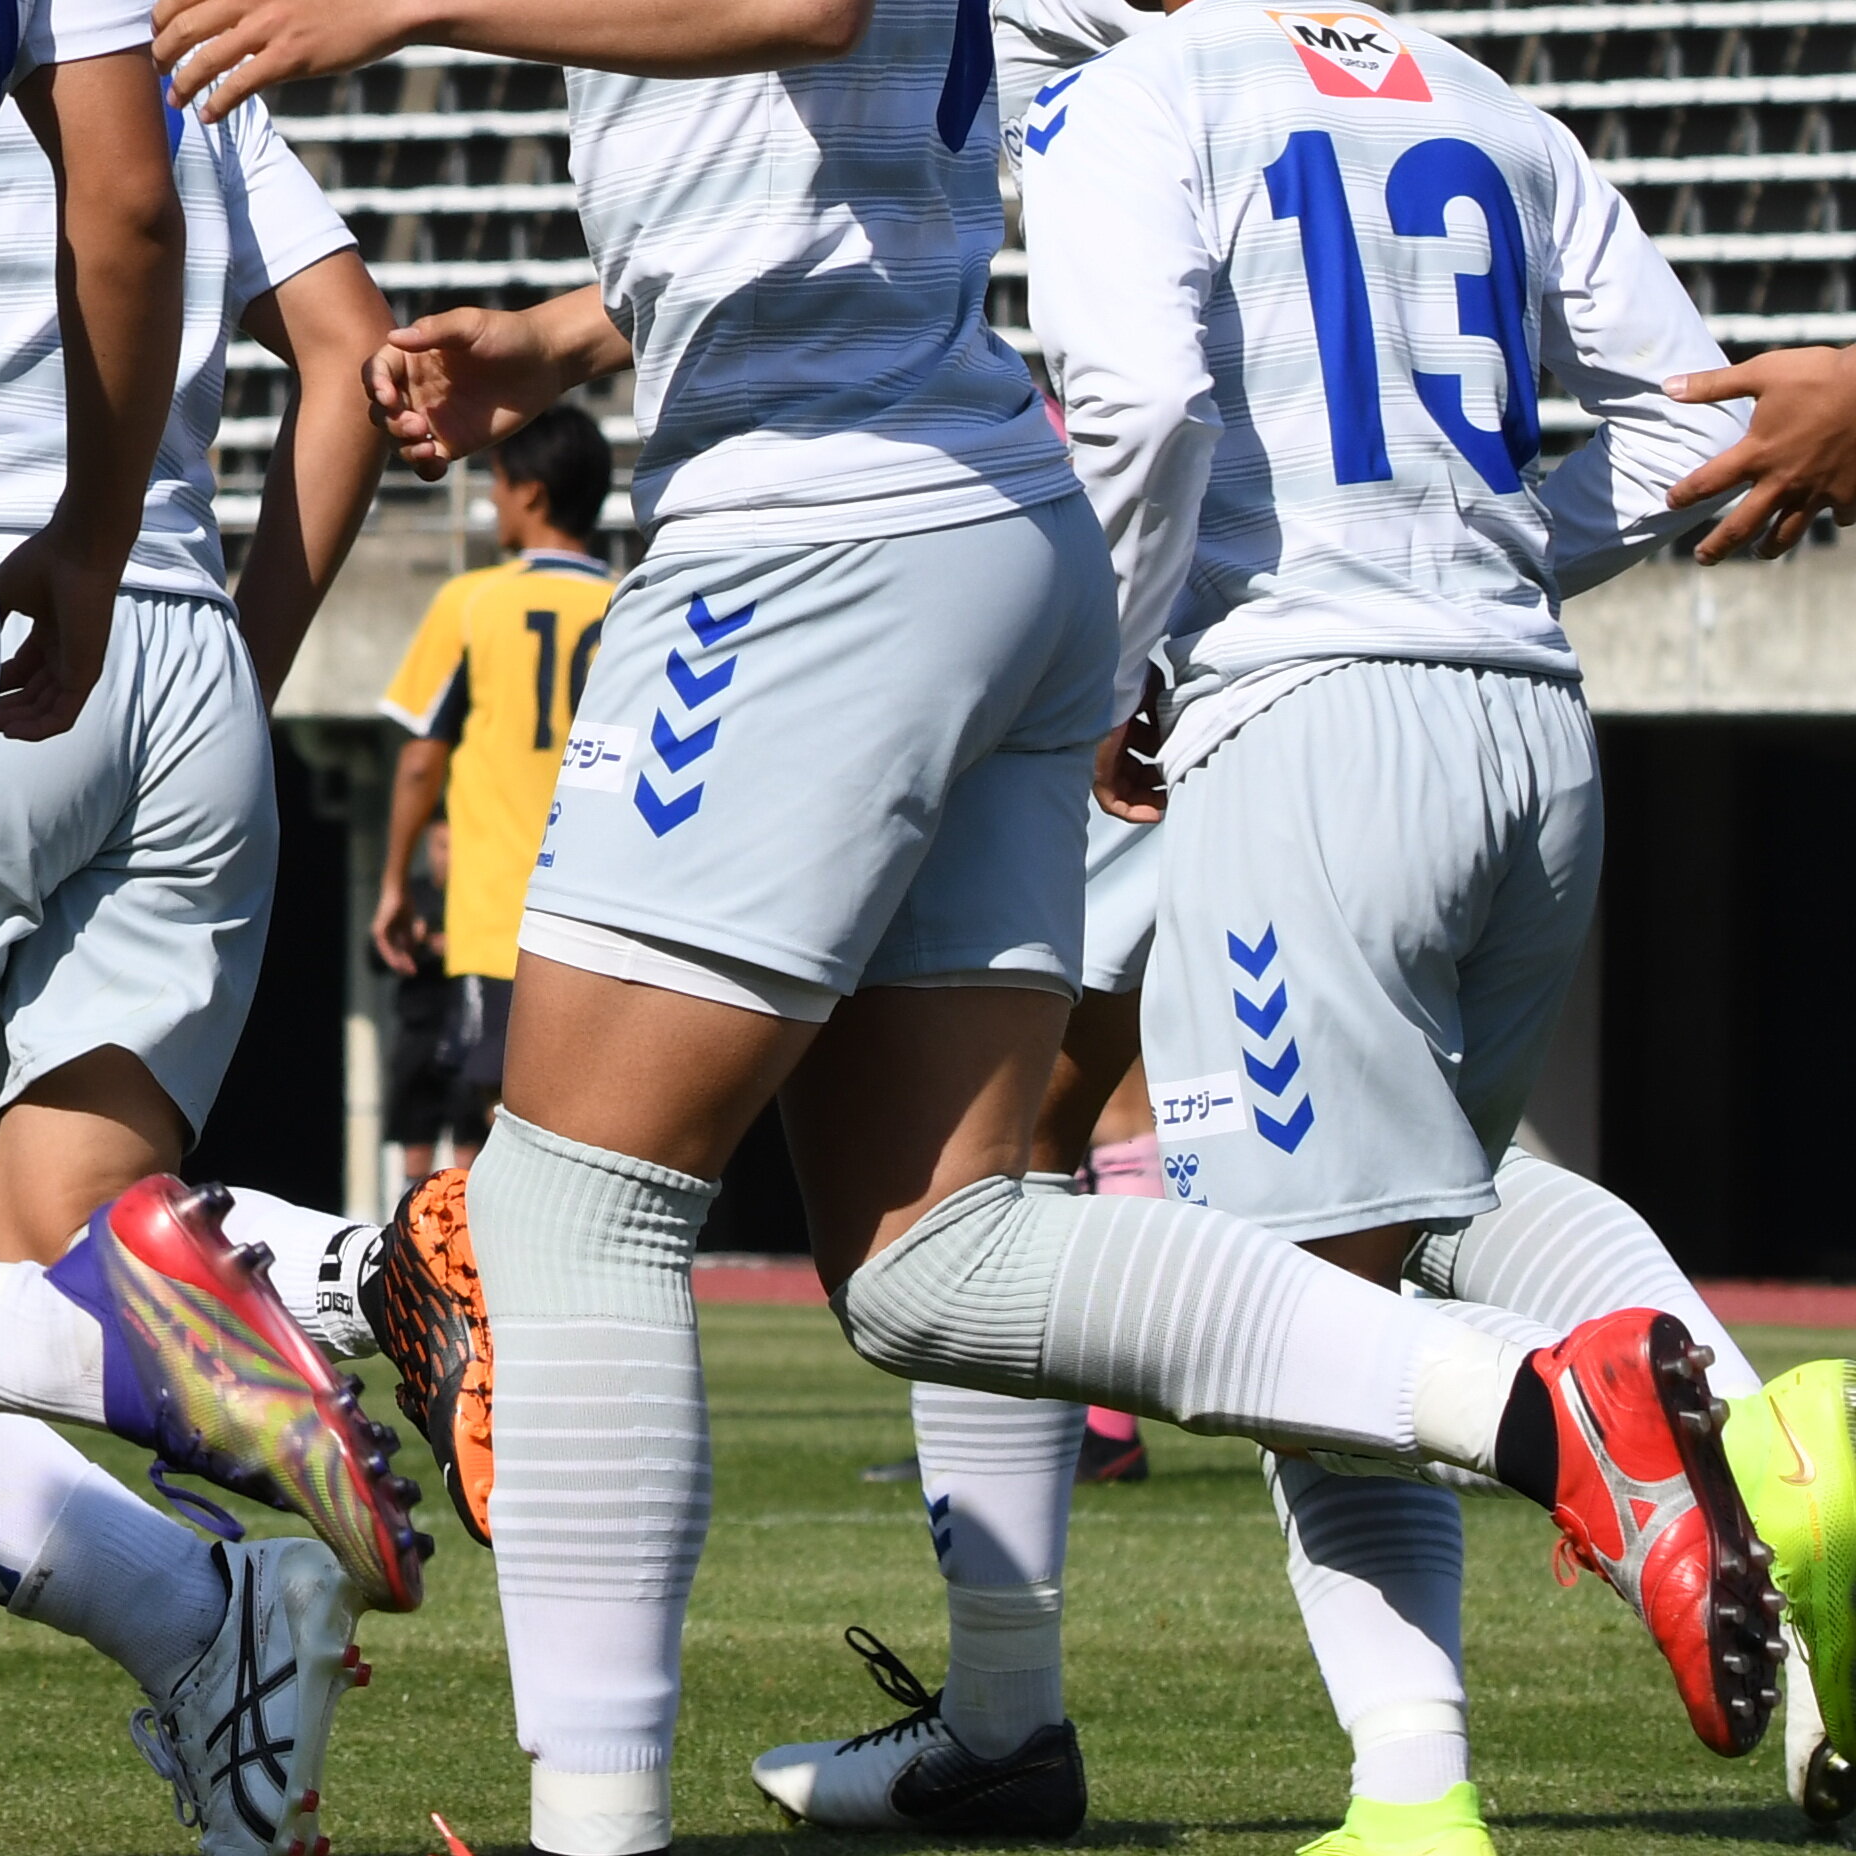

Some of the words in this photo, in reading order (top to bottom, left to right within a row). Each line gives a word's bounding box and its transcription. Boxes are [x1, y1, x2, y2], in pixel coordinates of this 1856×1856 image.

[1292, 25, 1396, 55] MK
[1263, 130, 1540, 495] 13
[1163, 1090, 1234, 1125] エナジー
